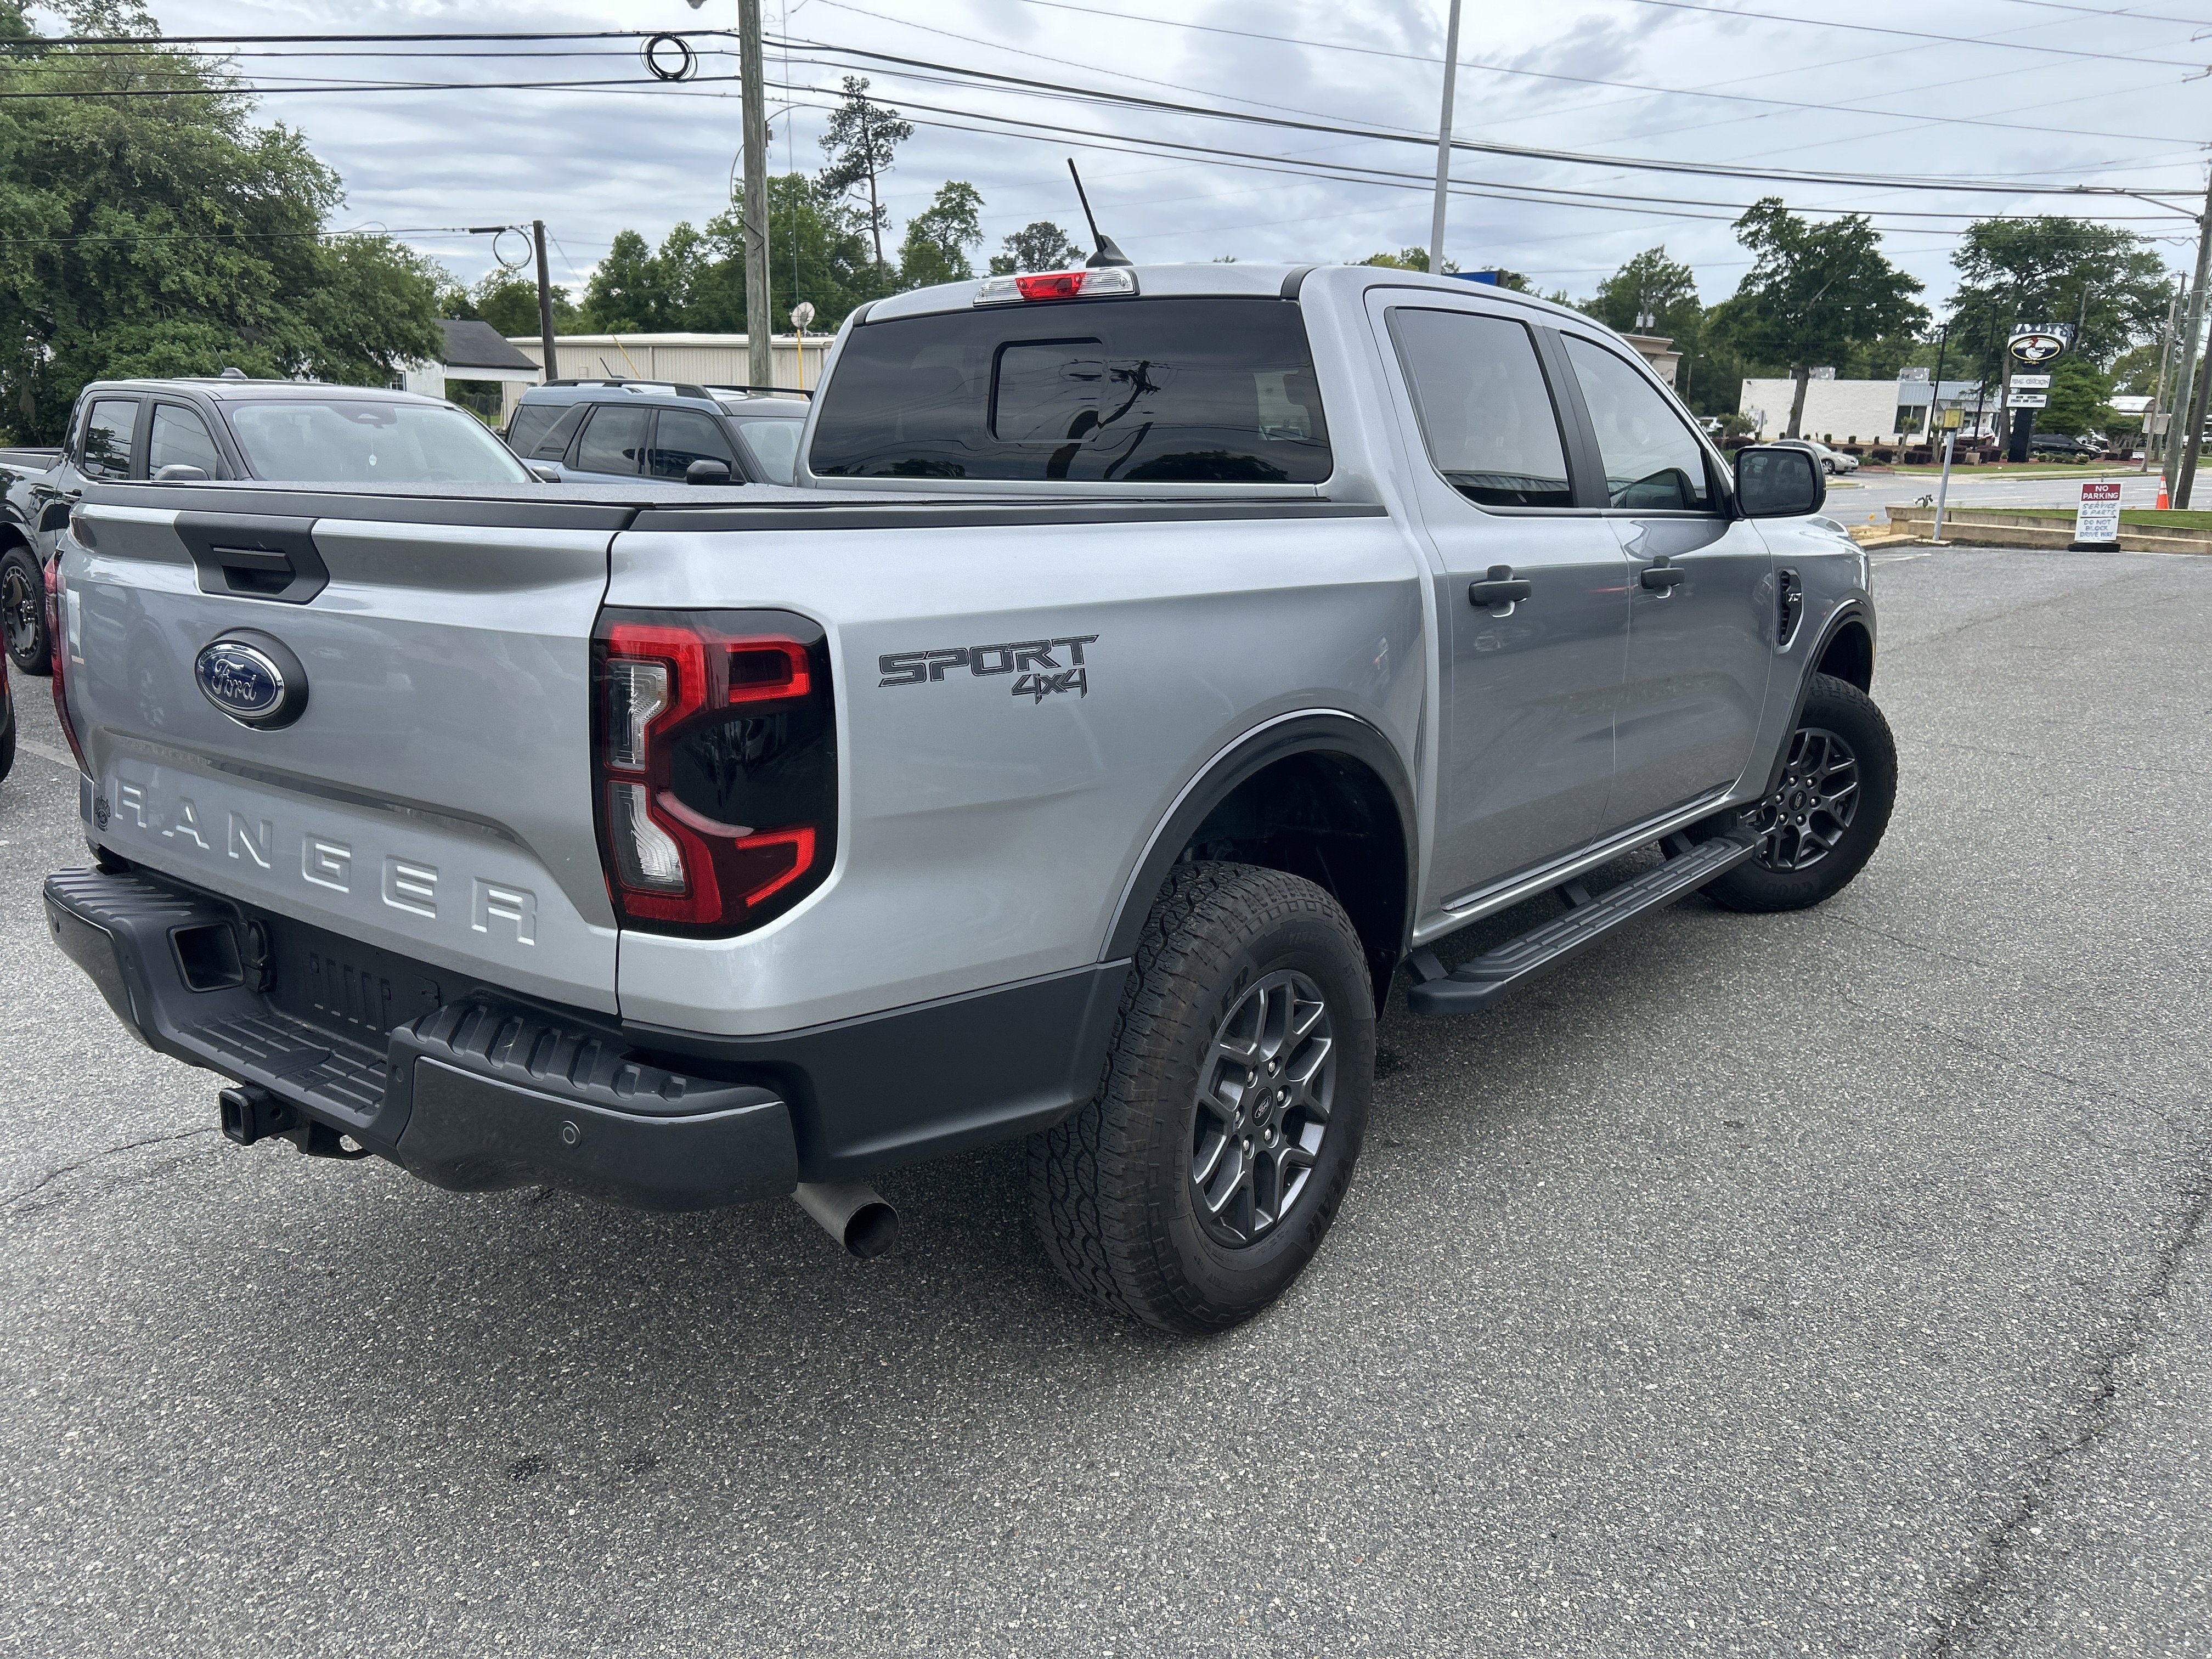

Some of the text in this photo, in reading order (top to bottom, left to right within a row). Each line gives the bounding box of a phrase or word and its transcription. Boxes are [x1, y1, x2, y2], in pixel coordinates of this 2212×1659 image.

[211, 658, 257, 701] Ford
[878, 635, 1099, 687] SPORT
[115, 778, 538, 946] RANGER
